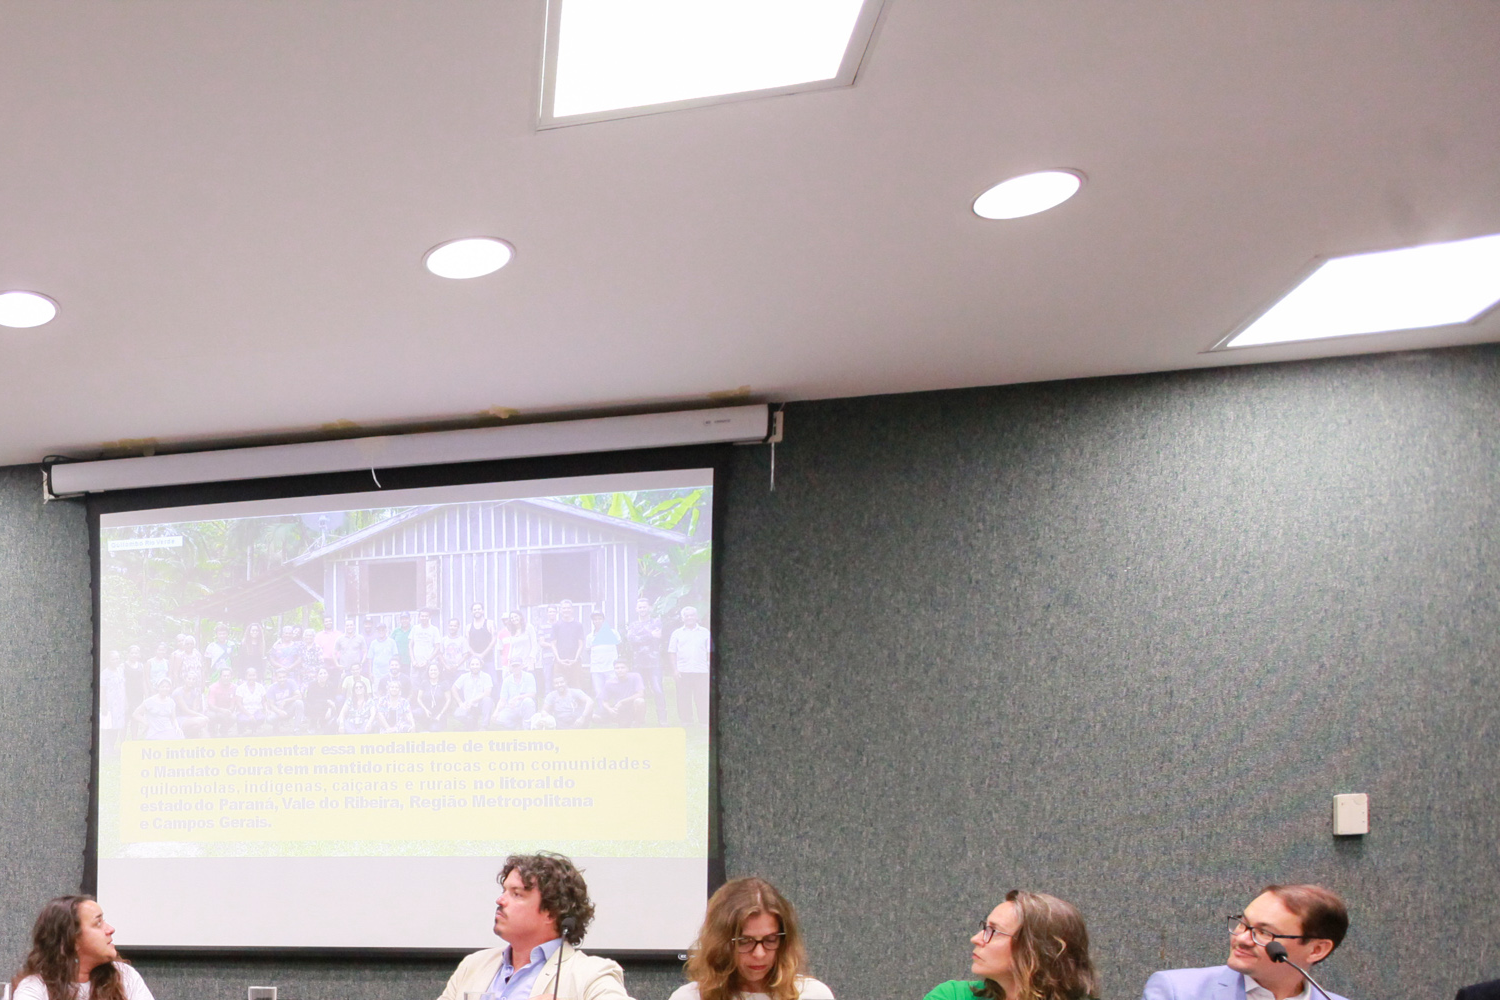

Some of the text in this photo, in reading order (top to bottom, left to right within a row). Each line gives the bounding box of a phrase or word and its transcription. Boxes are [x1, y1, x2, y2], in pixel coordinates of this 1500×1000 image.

[141, 739, 559, 760] No intuito de fomentar essa modalidade de turismo,
[141, 757, 651, 778] o Mandato Goura tem mantido ricas trocas com comunidades
[140, 776, 575, 798] quilombolas, indígenas, caiçaras e rurais no litoral do
[140, 794, 594, 812] estado do Paraná, Vale do Ribeira, Região Metropolitana
[140, 816, 272, 832] e Campos Gerais.
